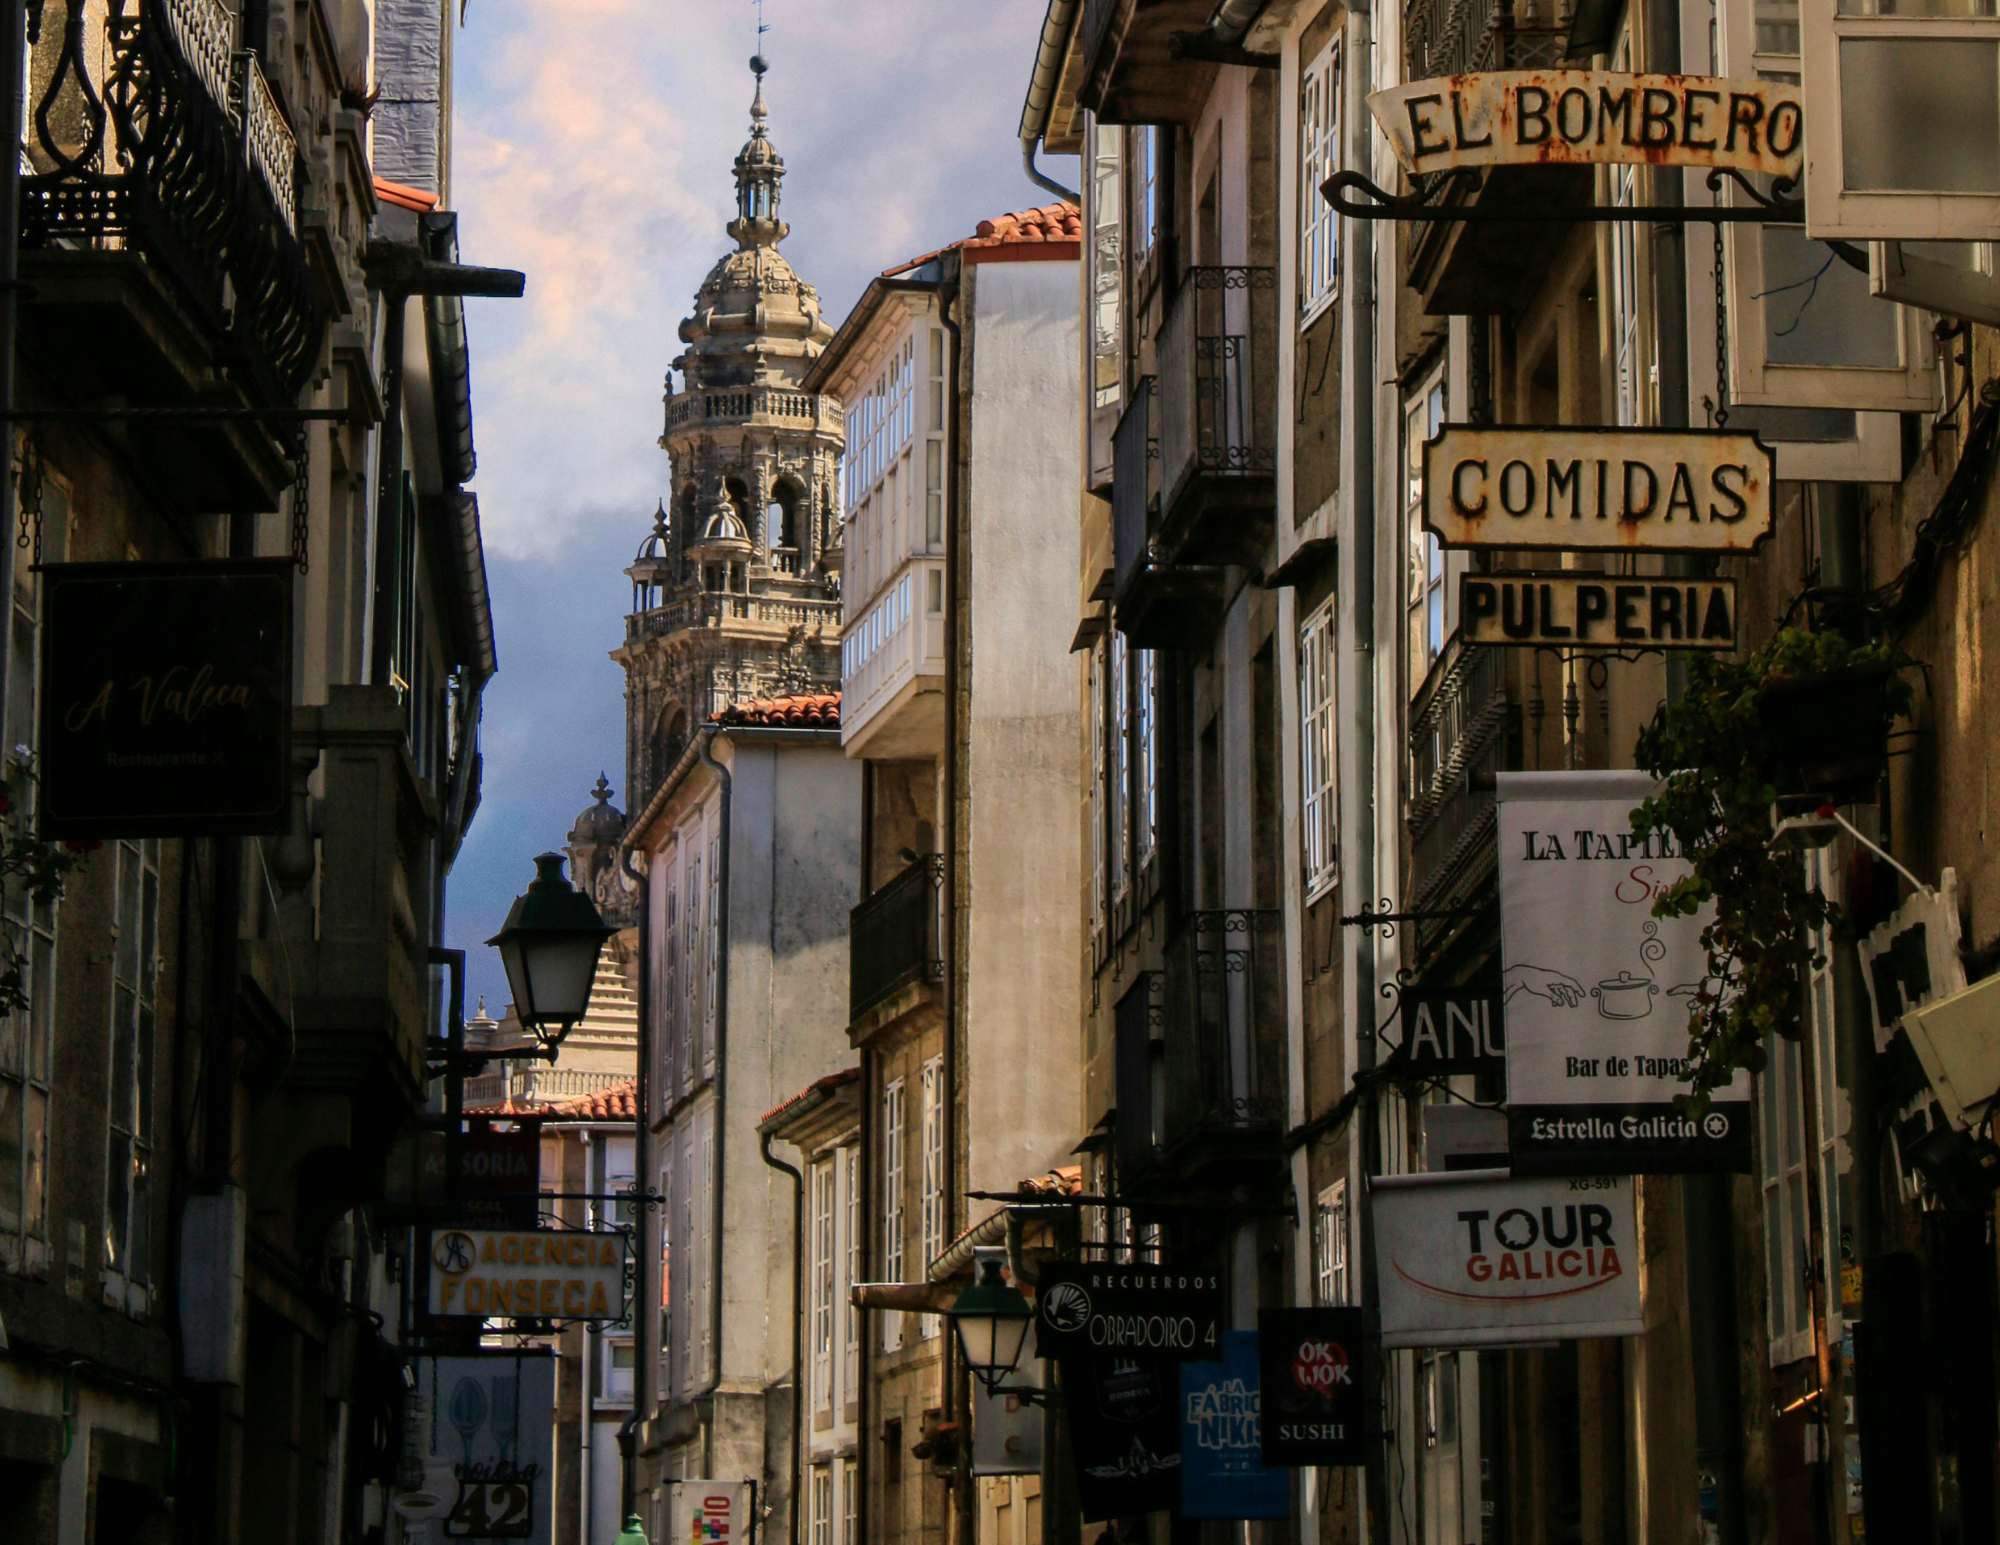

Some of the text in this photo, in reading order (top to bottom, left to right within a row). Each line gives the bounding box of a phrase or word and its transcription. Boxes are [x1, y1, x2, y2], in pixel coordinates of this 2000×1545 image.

[1404, 85, 1803, 158] EL BOMBERO
[1450, 458, 1752, 524] COMIDAS
[1466, 582, 1734, 640] PULPERIA
[64, 679, 116, 732] A
[105, 751, 209, 767] Restaurante
[1522, 831, 1566, 861] LA
[1566, 1056, 1599, 1078] Bar
[1606, 1055, 1629, 1077] de
[1531, 1115, 1699, 1140] Estrella Galicia
[1569, 1178, 1618, 1191] XG-591
[1458, 1204, 1614, 1254] TOUR
[481, 1236, 618, 1267] AGENCIA
[1466, 1246, 1623, 1283] GALICIA
[440, 1277, 609, 1316] FONSECA
[1092, 1275, 1218, 1290] RECUERDOS
[1089, 1313, 1217, 1349] OBRADOIRO 4
[1298, 1342, 1333, 1364] OK
[1298, 1362, 1353, 1387] WOK
[1279, 1424, 1345, 1441] SUSHI
[452, 1482, 529, 1536] 42
